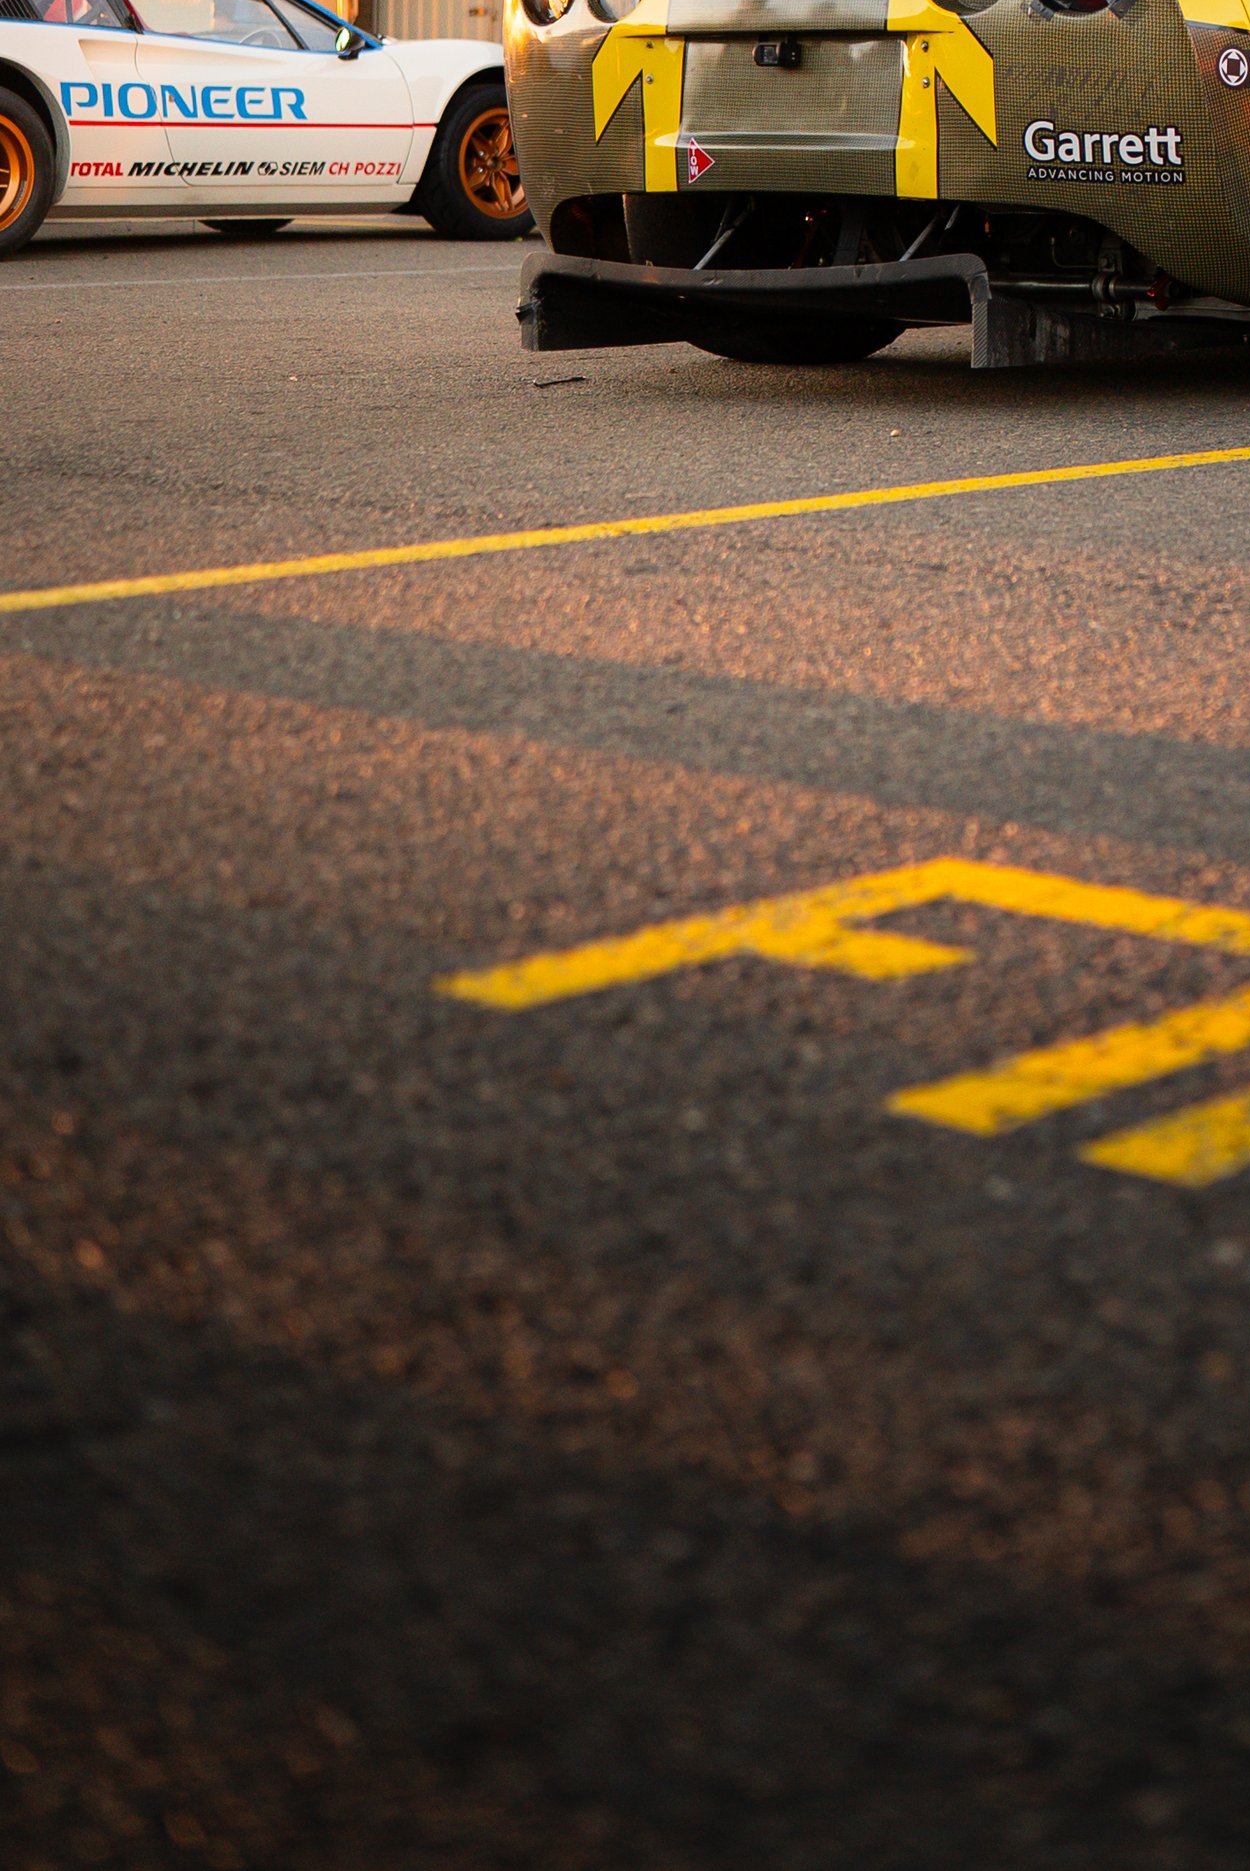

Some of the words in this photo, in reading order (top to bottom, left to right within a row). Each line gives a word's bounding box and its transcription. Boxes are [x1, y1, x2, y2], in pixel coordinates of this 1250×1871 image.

[60, 81, 308, 121] PIONEER
[1024, 120, 1183, 165] Garrett
[71, 161, 124, 177] TOTAL
[127, 161, 257, 177] MICHELIN
[279, 161, 326, 177] SIEM
[328, 161, 351, 177] CH
[354, 162, 402, 178] POZZI
[689, 146, 699, 176] TOW
[1028, 168, 1115, 183] ADVANCING
[1121, 170, 1184, 184] MOTION
